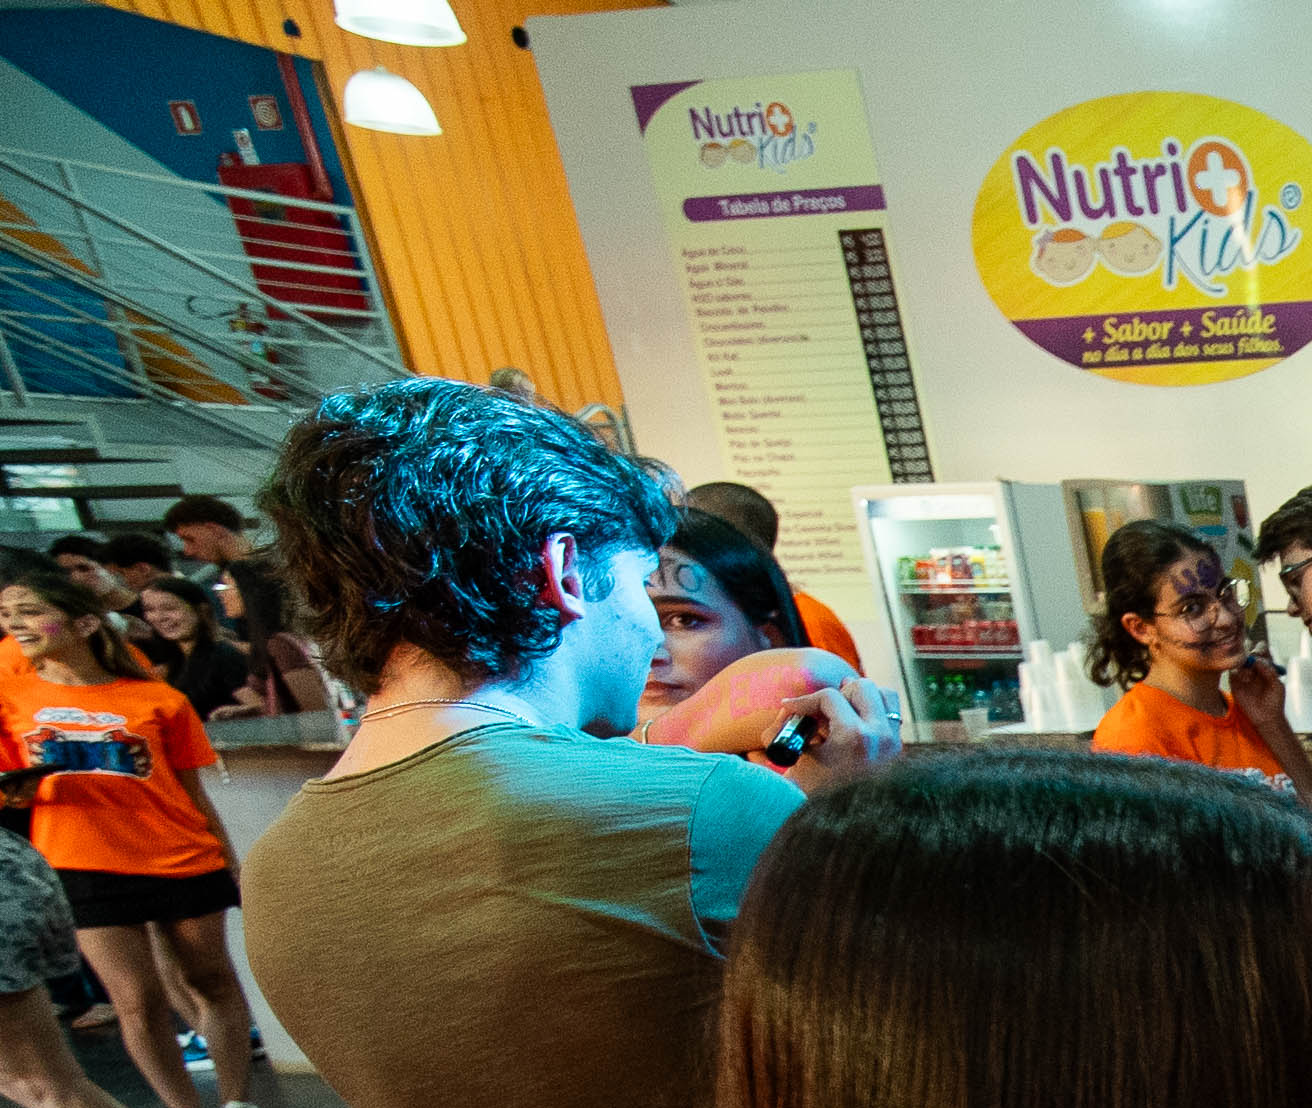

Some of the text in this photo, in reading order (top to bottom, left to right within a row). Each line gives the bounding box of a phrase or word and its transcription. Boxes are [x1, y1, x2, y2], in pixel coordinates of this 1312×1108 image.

[688, 102, 767, 139] Nutri
[1015, 142, 1188, 225] Nutri
[719, 194, 848, 217] Tabela de Preços
[1166, 190, 1294, 293] Kids
[1102, 316, 1174, 344] Sabor
[1199, 308, 1277, 339] Saúde
[1082, 351, 1102, 363] no
[1104, 344, 1130, 362] dia
[1132, 348, 1143, 361] a
[1146, 342, 1171, 360] dia
[1173, 341, 1200, 357] dos
[1203, 342, 1235, 356] seus
